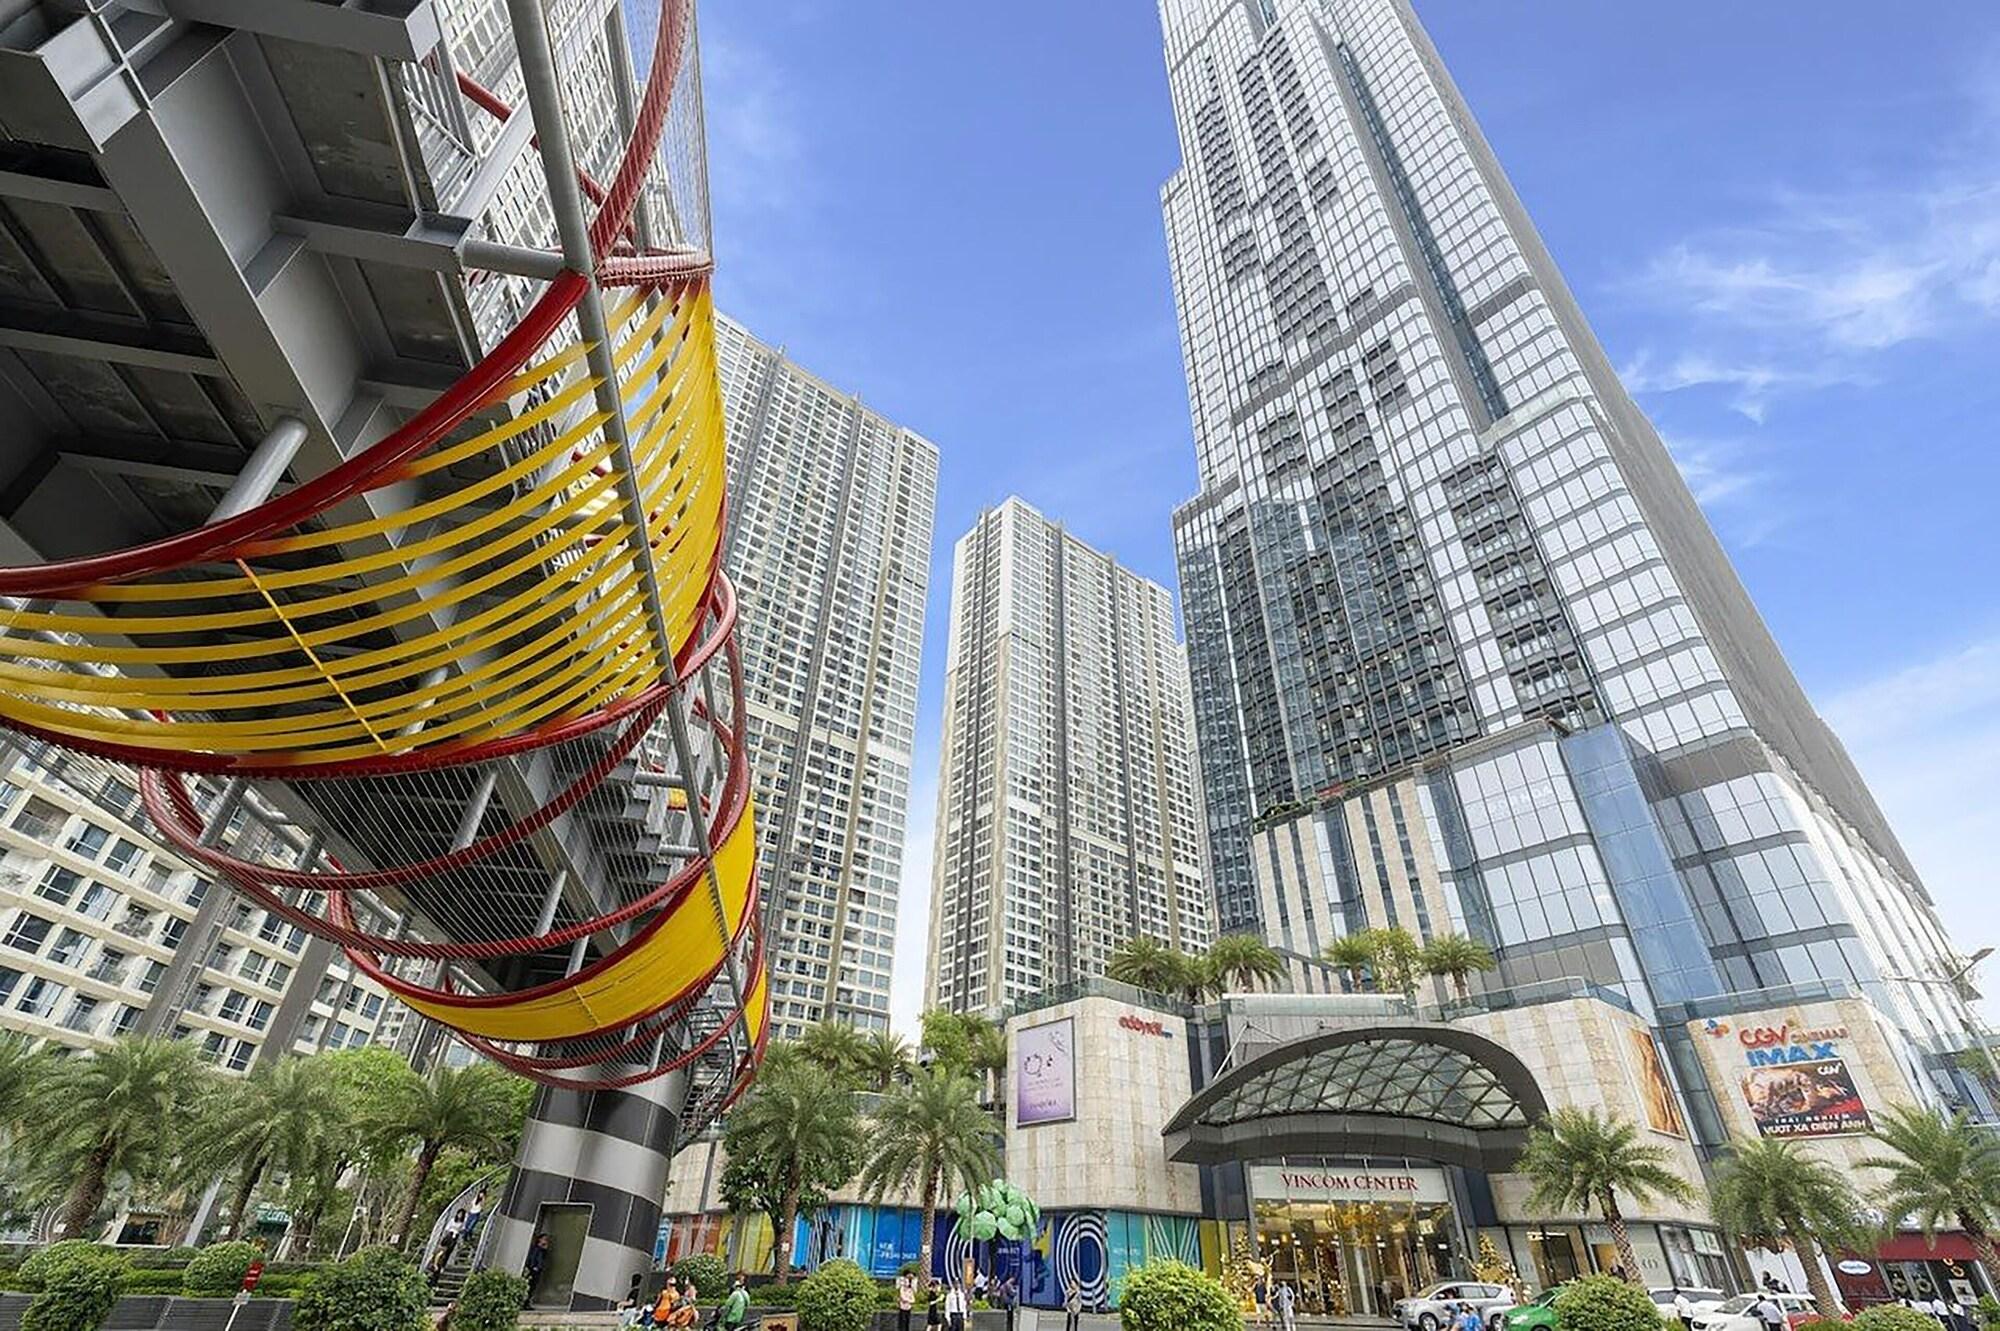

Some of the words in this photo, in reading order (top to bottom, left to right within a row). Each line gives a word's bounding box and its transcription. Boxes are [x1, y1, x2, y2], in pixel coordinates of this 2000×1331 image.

[1740, 1025, 1786, 1049] CGV
[1746, 1042, 1839, 1067] IMAX
[1281, 1173, 1350, 1189] VINCOM
[1354, 1175, 1418, 1190] CENTER
